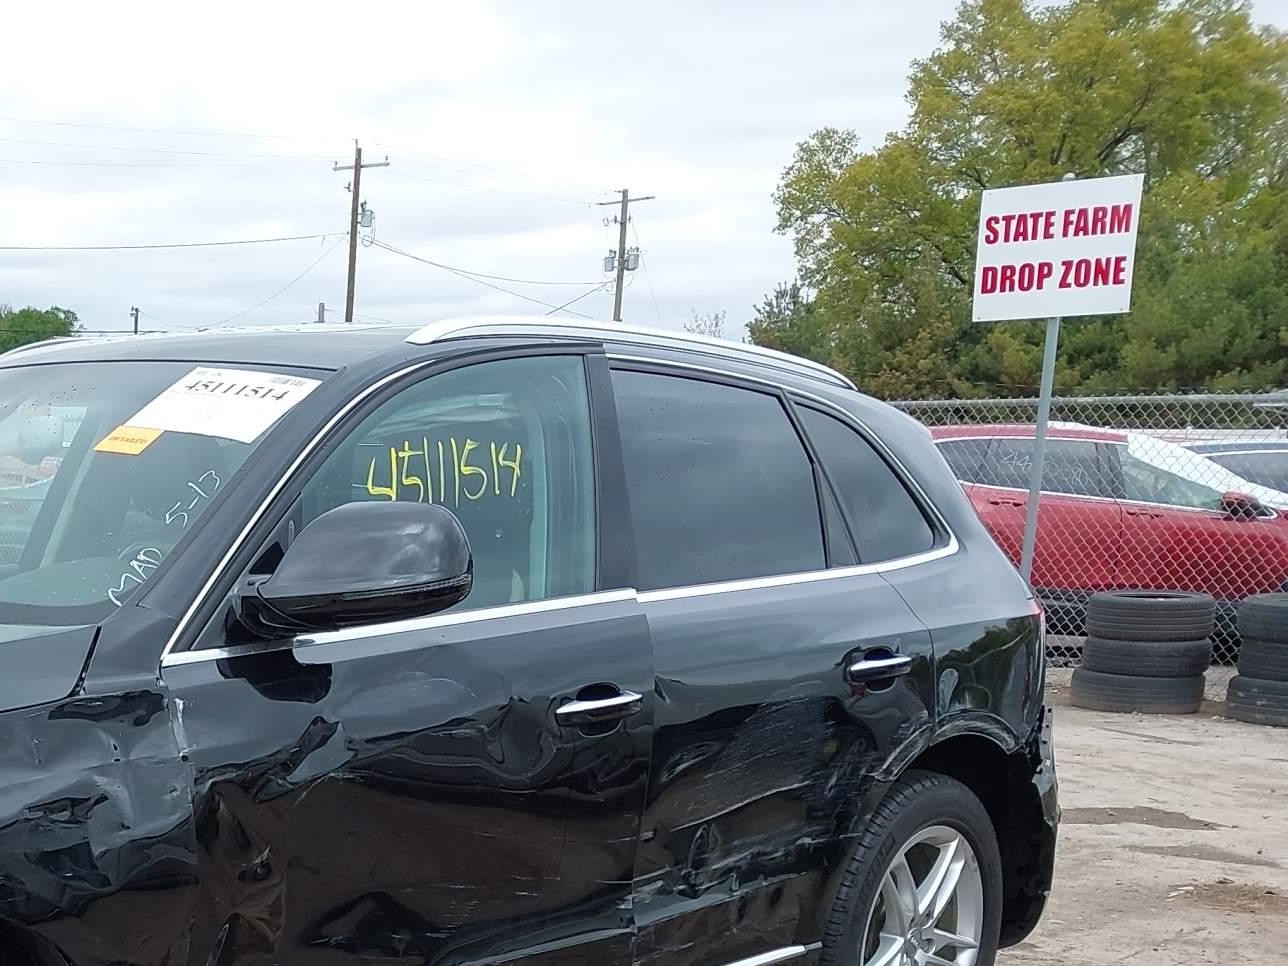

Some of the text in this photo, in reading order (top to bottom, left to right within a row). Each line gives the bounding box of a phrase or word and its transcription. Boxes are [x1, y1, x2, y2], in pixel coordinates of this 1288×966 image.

[985, 203, 1134, 245] STATE FARM
[980, 256, 1127, 295] DROP ZONE
[185, 380, 290, 401] 45111514
[367, 436, 522, 509] 45111514
